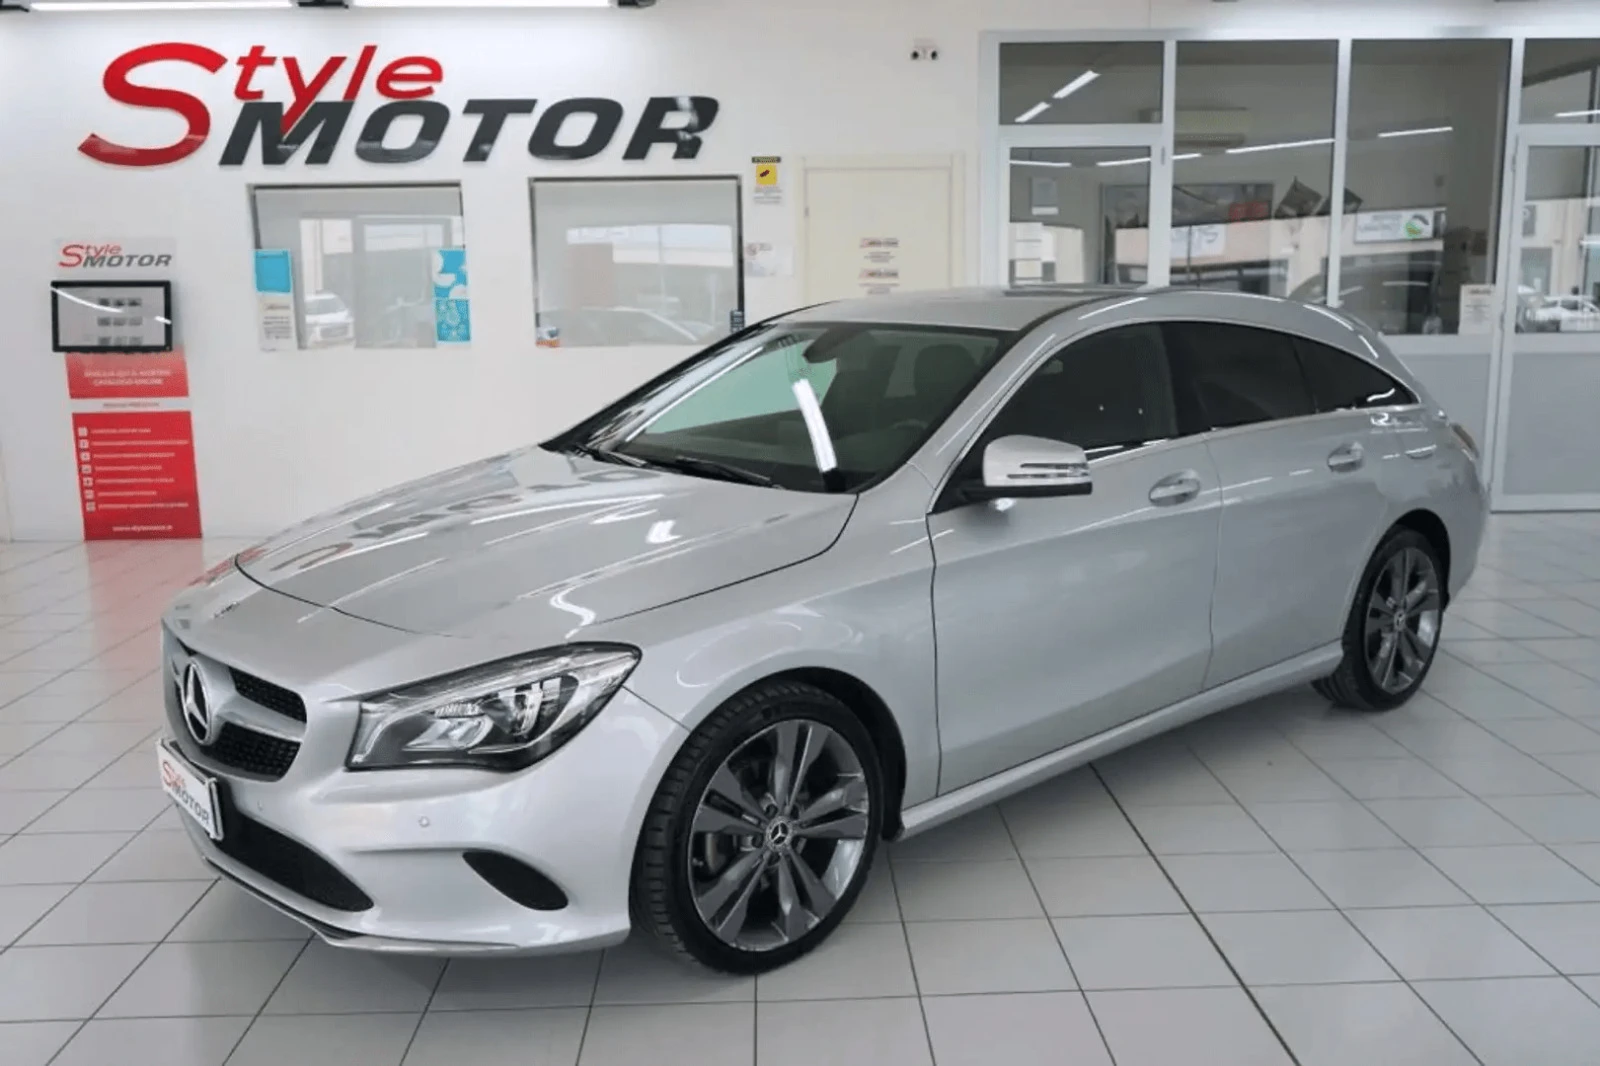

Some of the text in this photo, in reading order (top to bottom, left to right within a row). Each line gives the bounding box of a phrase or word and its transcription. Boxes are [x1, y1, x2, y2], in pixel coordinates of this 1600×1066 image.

[78, 42, 443, 167] Style
[218, 95, 720, 167] MOTOR
[59, 244, 122, 268] Style
[83, 254, 172, 268] MOTOR
[172, 785, 210, 825] MOTOR
